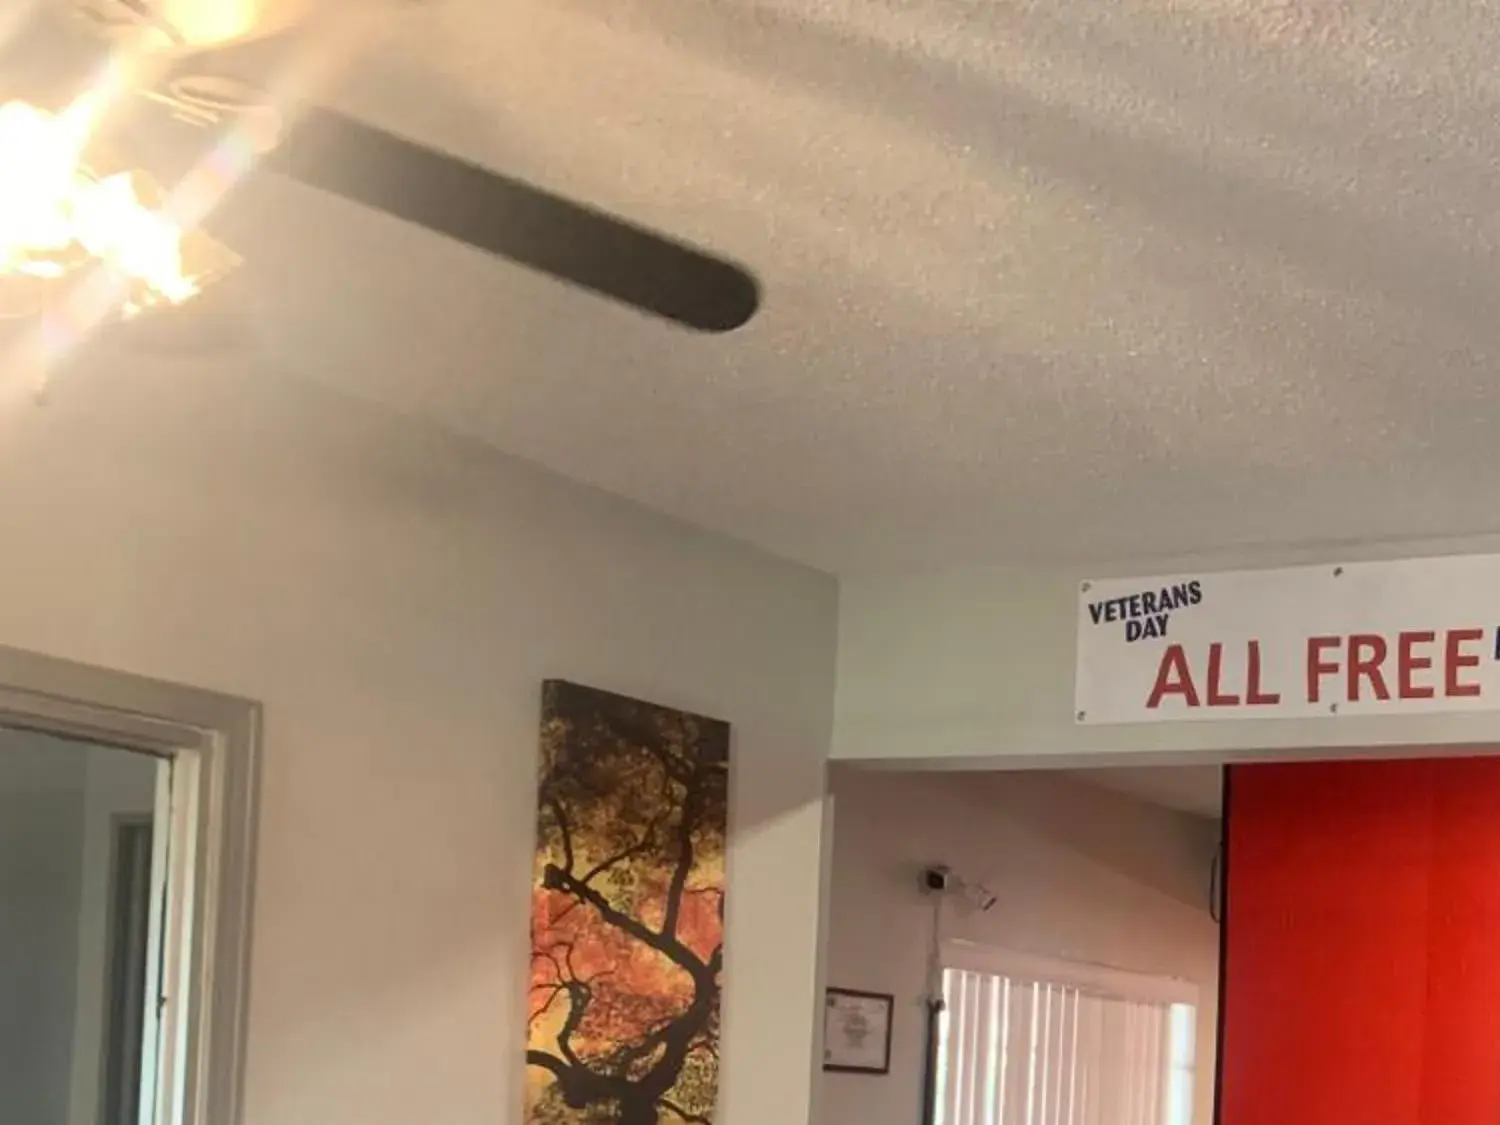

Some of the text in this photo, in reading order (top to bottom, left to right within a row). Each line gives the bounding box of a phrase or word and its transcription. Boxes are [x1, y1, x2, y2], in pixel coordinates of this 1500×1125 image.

[1088, 580, 1203, 625] VETERANS
[1125, 613, 1169, 642] DAY
[1146, 628, 1484, 708] ALL FREE
